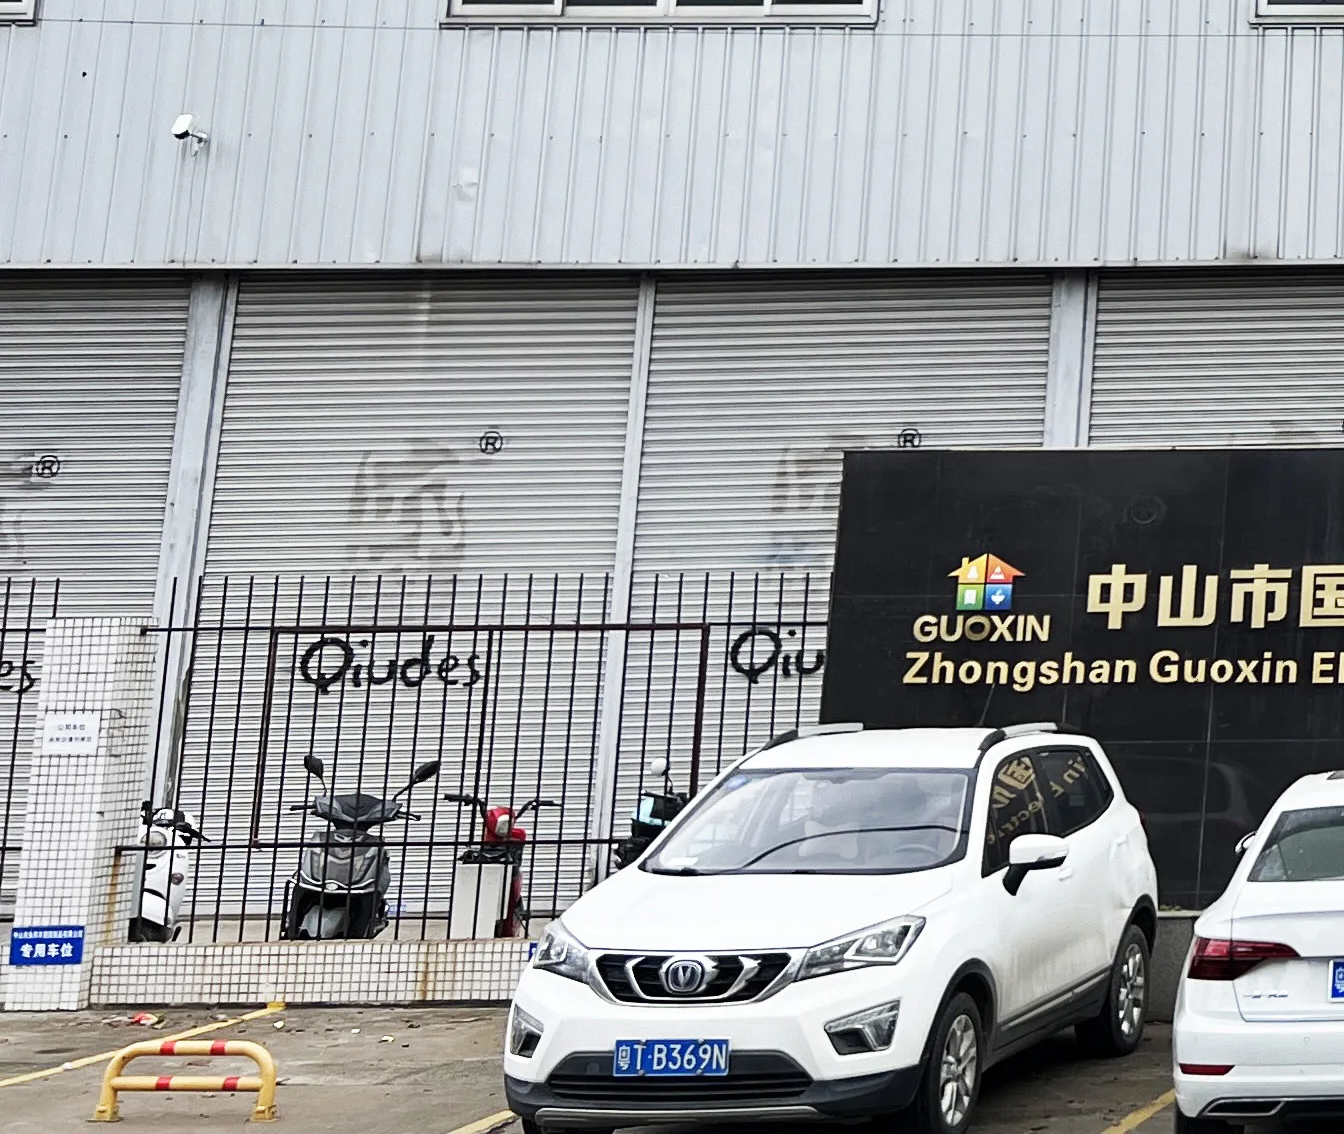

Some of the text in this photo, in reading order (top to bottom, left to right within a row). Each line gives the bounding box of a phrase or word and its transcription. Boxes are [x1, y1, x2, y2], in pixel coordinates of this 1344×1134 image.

[912, 614, 1051, 643] GUOXIN
[299, 634, 482, 695] Qiudes
[902, 651, 1137, 692] Zhongshan
[1149, 650, 1298, 684] Guoxin
